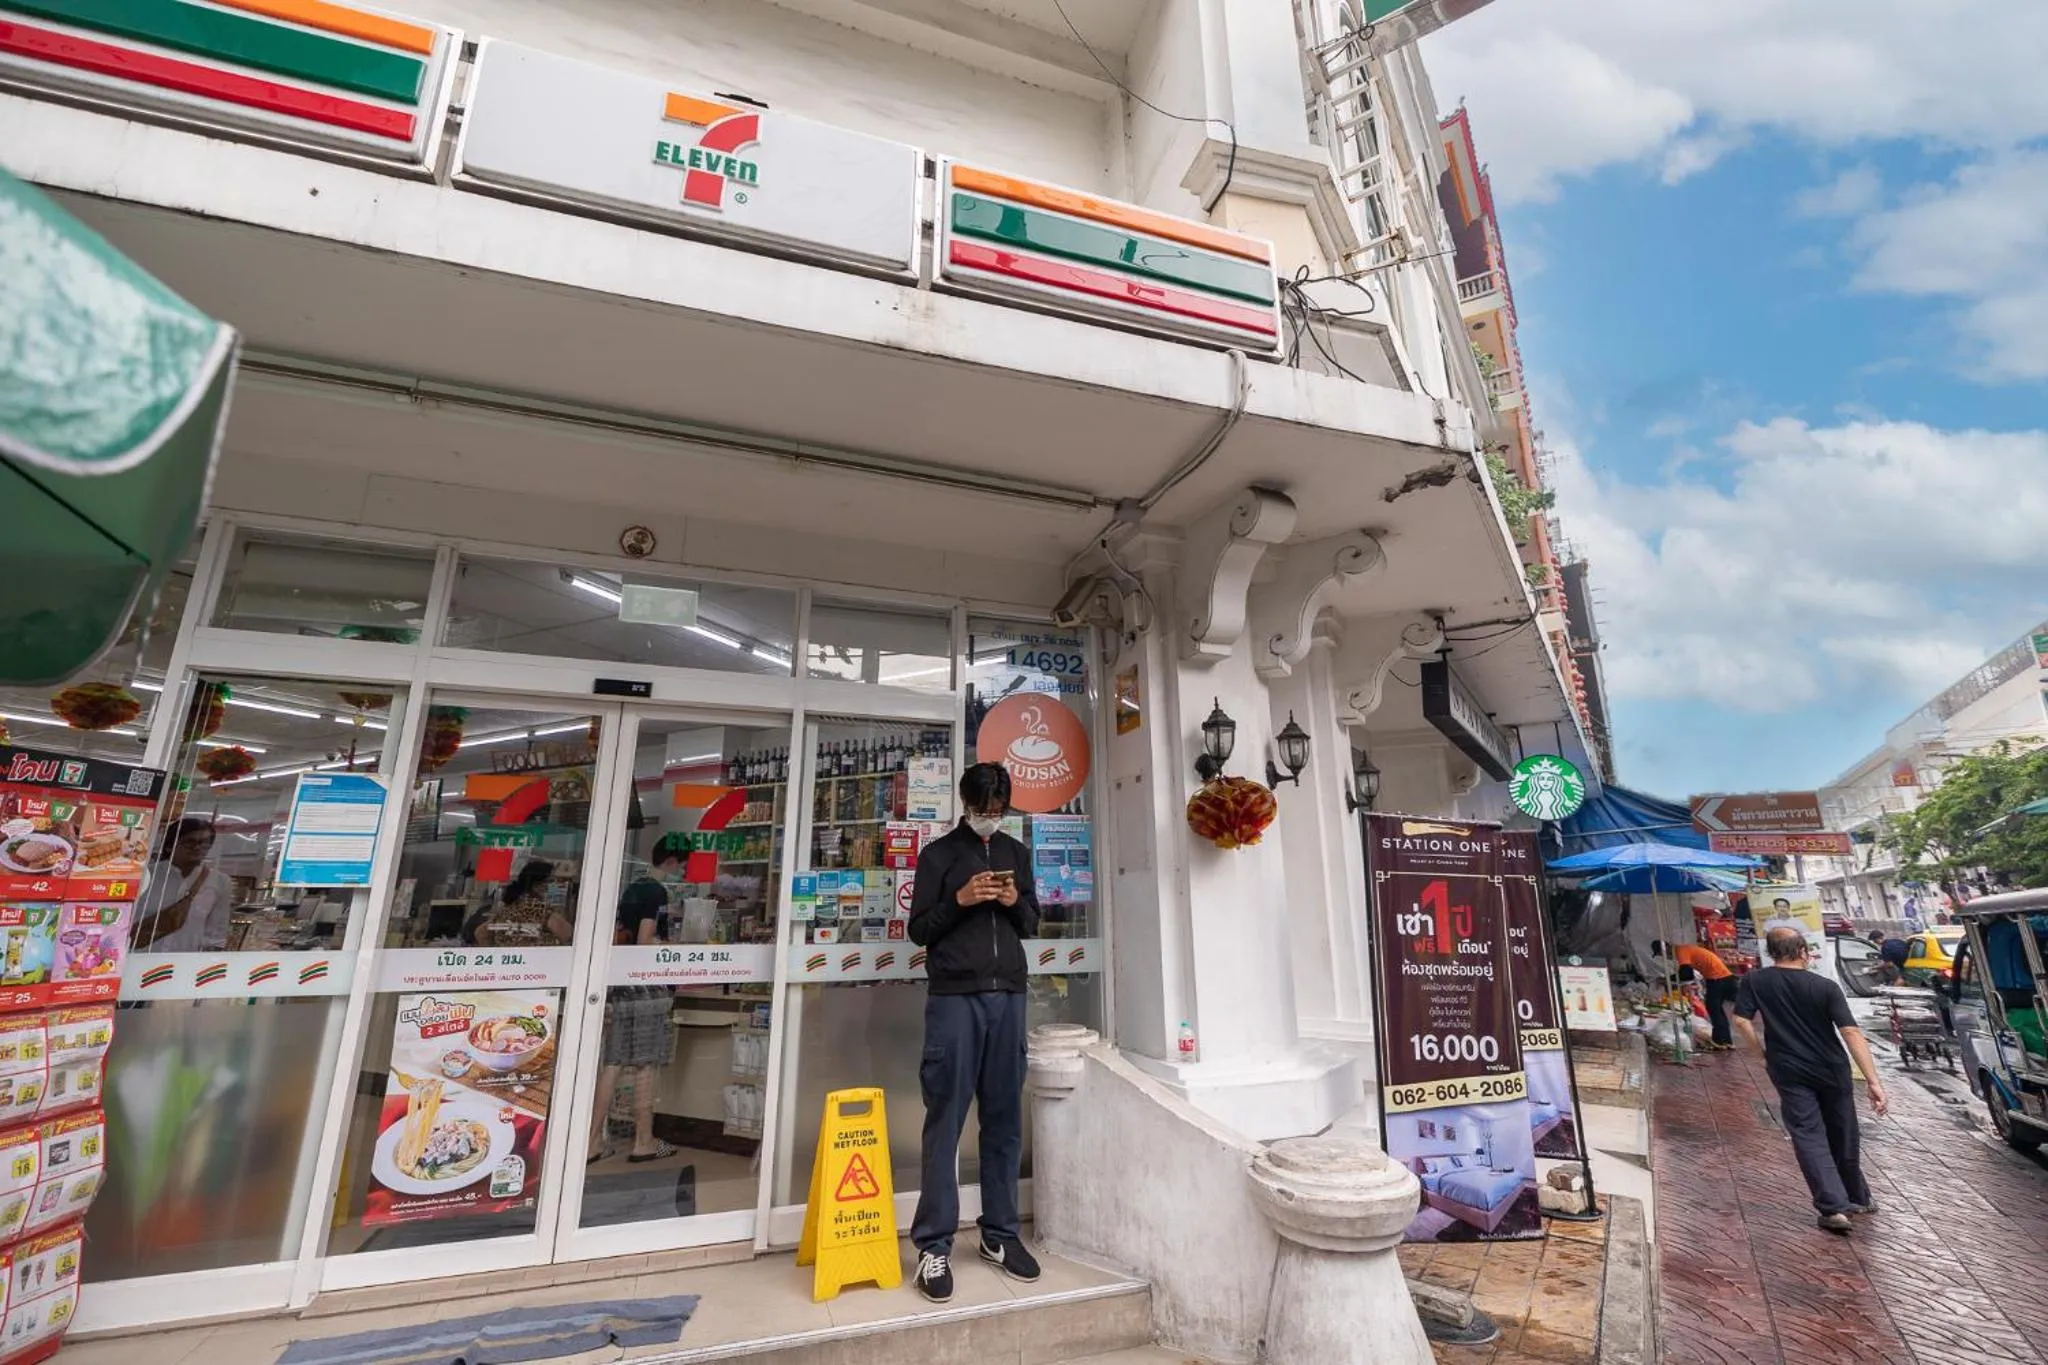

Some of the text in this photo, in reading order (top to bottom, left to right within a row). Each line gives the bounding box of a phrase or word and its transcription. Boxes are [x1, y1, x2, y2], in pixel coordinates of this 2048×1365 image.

[1007, 648, 1084, 675] 14692
[1382, 837, 1491, 853] STATION ONE
[1397, 903, 1434, 936] เช่า
[438, 951, 466, 966] เปิด
[474, 954, 494, 966] 24
[655, 948, 681, 963] เปิด
[687, 952, 705, 962] 24
[1402, 958, 1494, 981] ห้องชุดพร้อมอยู่
[1410, 1034, 1499, 1063] 16,000
[1392, 1077, 1523, 1106] 062-604-2086
[837, 1129, 874, 1140] CAUTION
